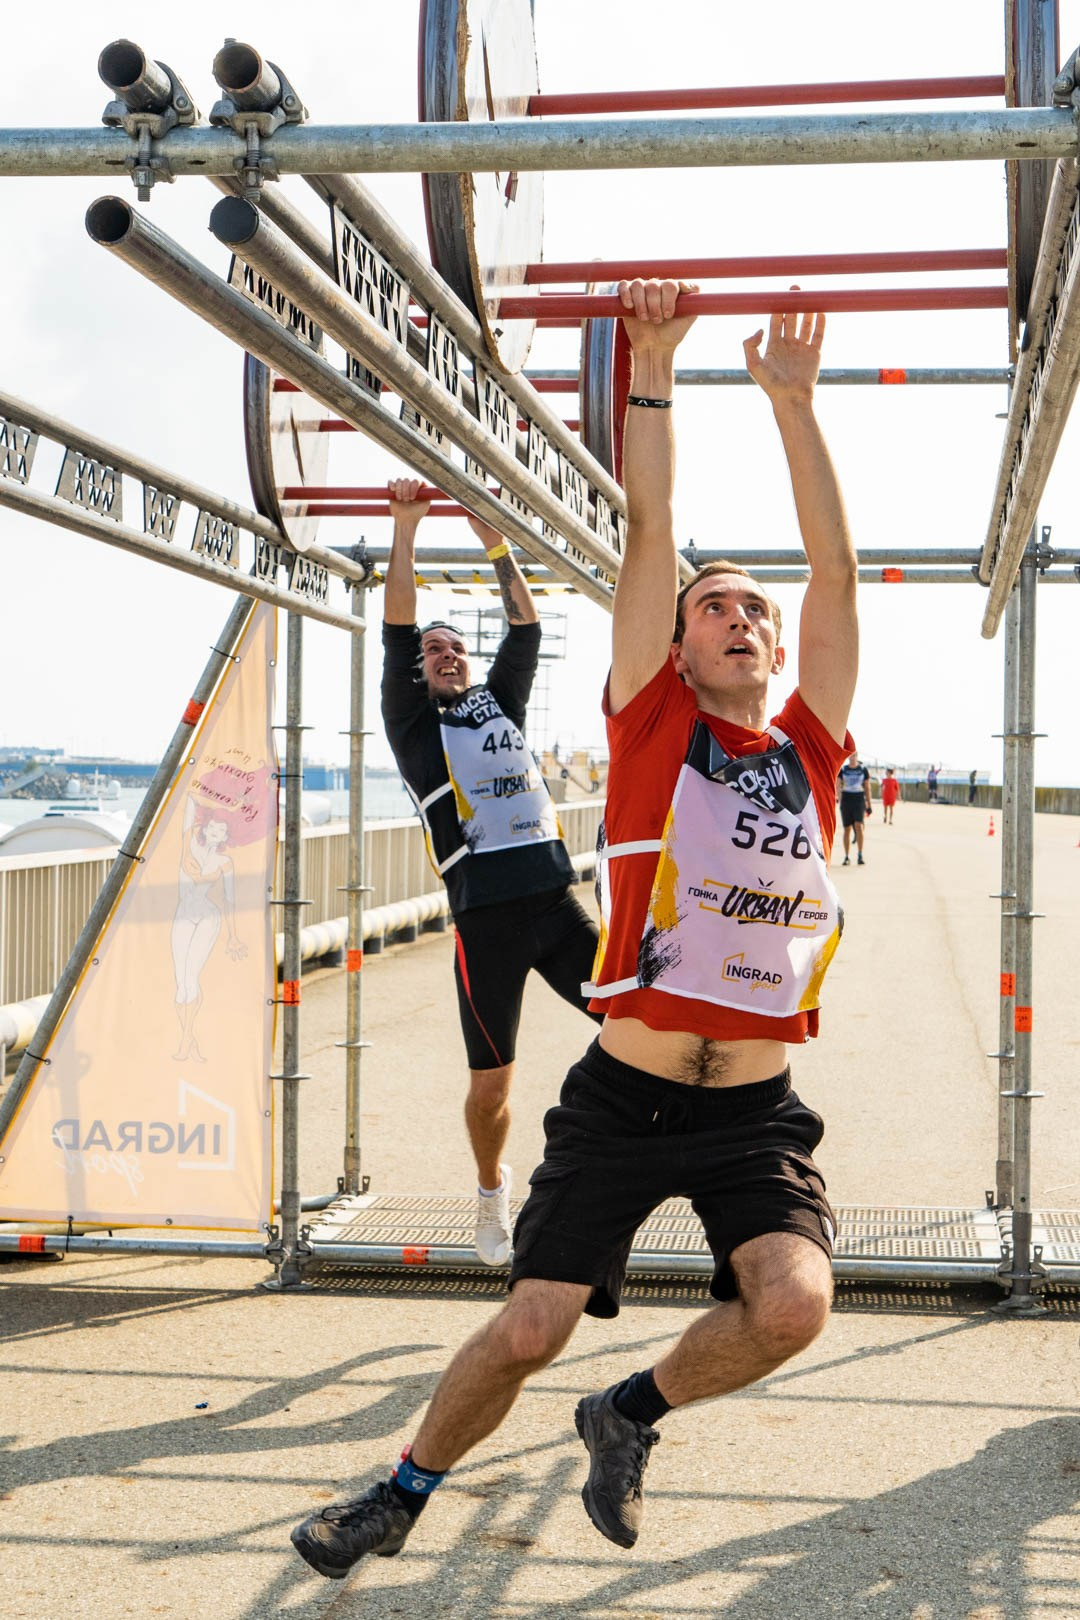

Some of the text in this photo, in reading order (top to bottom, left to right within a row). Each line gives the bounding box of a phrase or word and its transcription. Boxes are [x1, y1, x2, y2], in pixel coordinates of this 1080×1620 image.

[493, 768, 531, 799] URBAN
[731, 810, 811, 860] 526
[688, 885, 828, 927] ГОНКА URBAN ГЕРОЕВ
[726, 964, 783, 985] INGRAD
